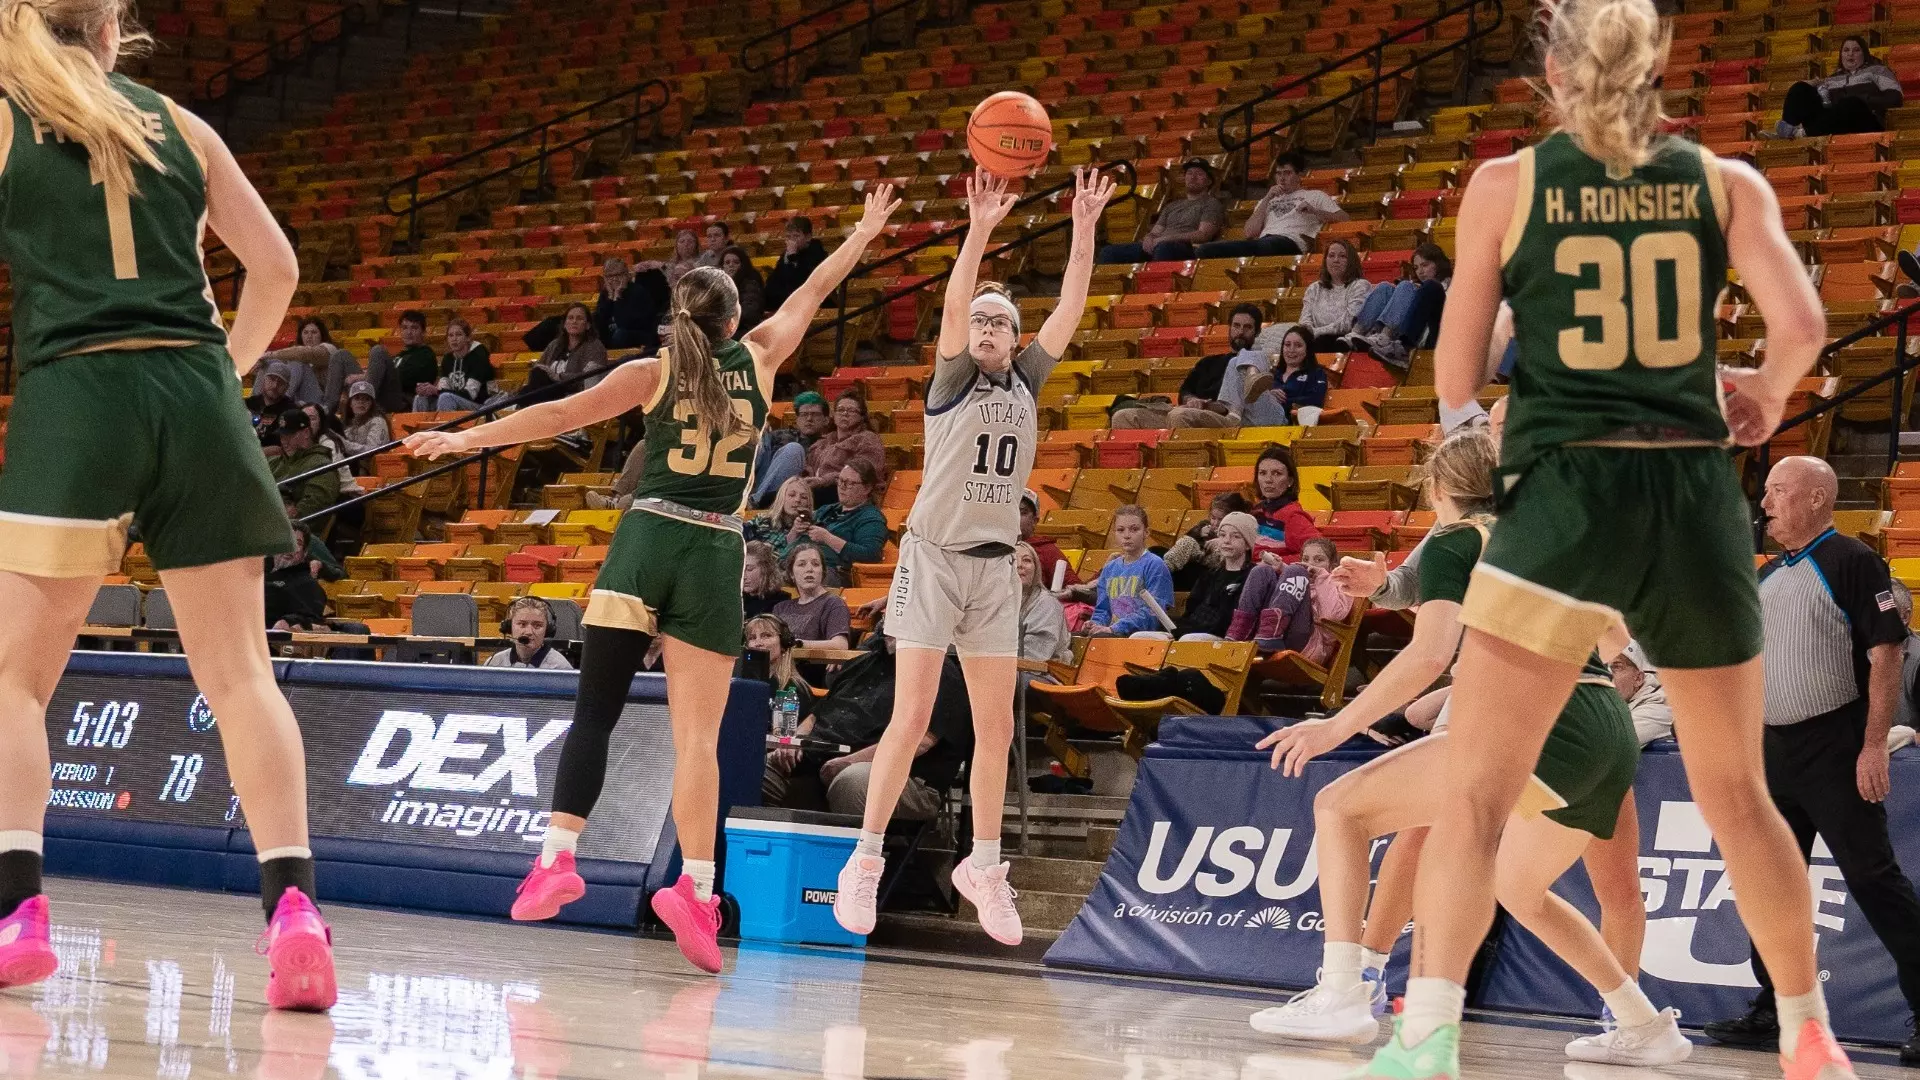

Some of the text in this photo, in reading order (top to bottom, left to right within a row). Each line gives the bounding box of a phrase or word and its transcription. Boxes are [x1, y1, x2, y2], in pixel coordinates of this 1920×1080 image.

[1000, 135, 1043, 151] ELITE
[89, 157, 139, 279] 1
[1545, 183, 1700, 224] H. RONSIEK
[1555, 231, 1702, 370] 30
[667, 398, 753, 478] 32
[979, 402, 1027, 428] UTAH
[972, 432, 1018, 478] 10
[963, 481, 1013, 504] STATE
[896, 565, 910, 617] AGGIES
[66, 701, 140, 748] 5:03
[52, 762, 114, 786] PERIOD 1
[346, 710, 574, 796] DEX
[46, 788, 116, 810] OSSESSION
[159, 754, 203, 802] 78
[380, 791, 552, 842] imaging
[1137, 821, 1318, 900] USU
[805, 890, 837, 904] POWE
[1113, 901, 1246, 928] a division of
